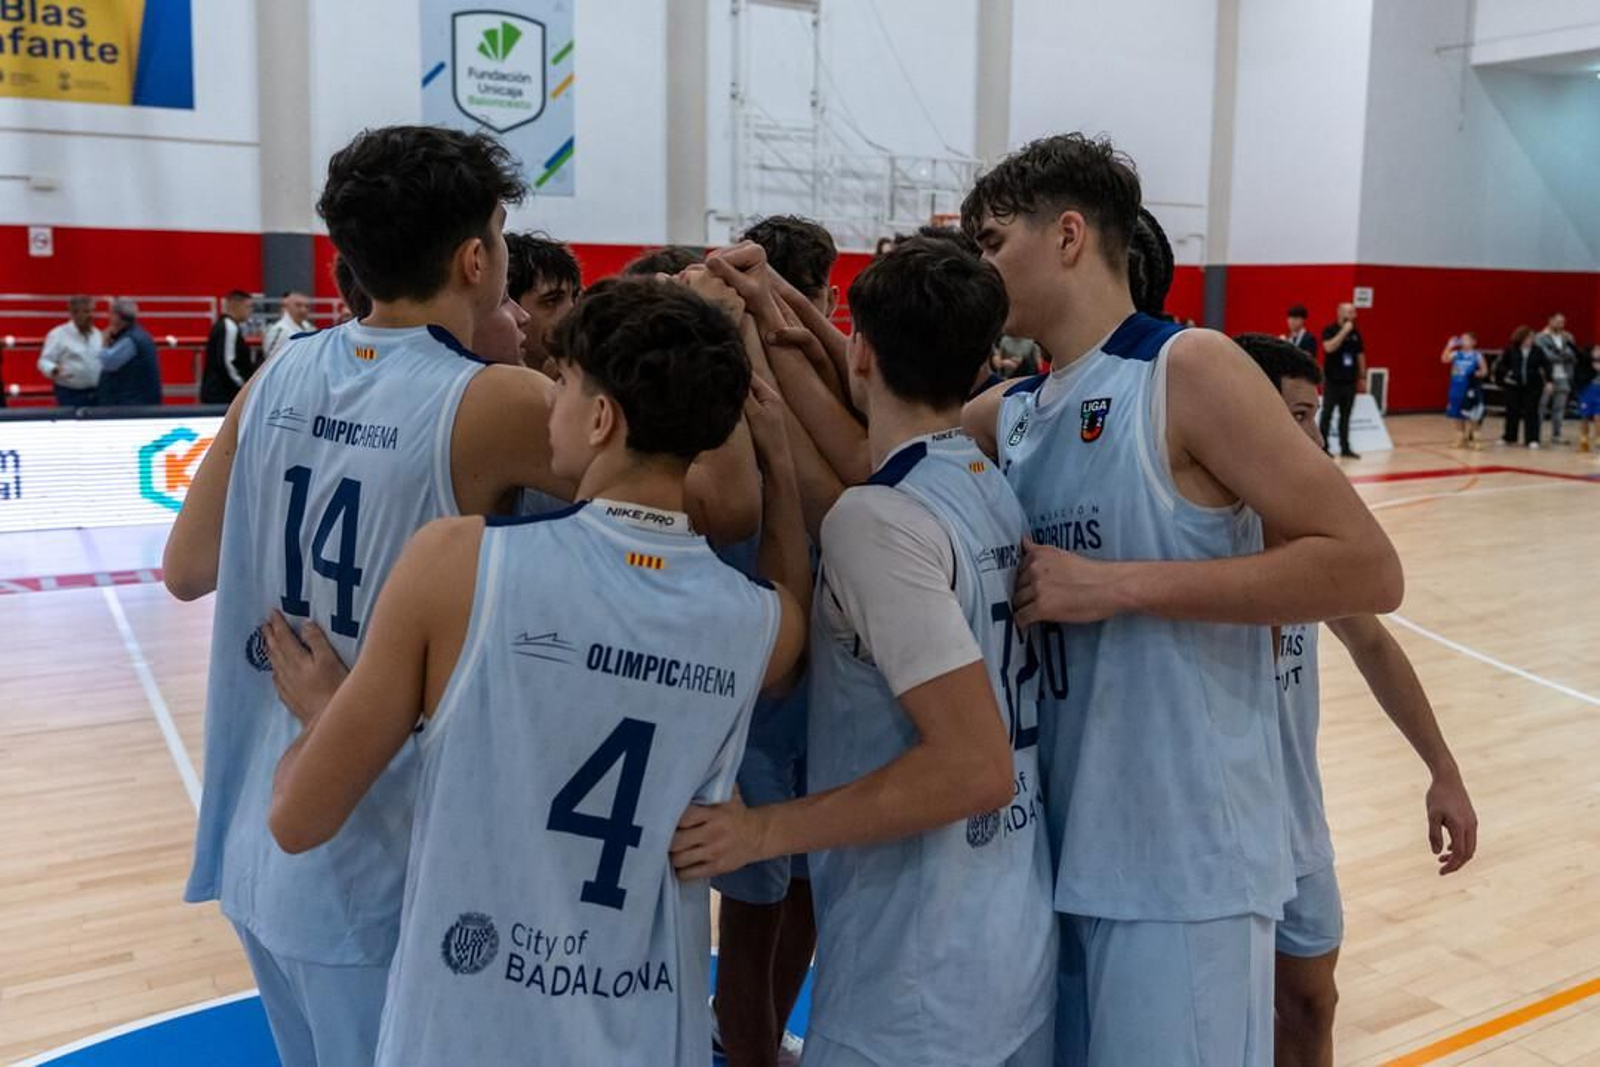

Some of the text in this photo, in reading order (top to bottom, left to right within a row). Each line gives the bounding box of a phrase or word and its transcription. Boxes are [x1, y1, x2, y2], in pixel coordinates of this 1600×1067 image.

[0, 0, 86, 29] Blas
[0, 27, 119, 64] fante
[468, 66, 532, 84] Fundación
[477, 83, 523, 98] Unicaja
[606, 507, 675, 526] NIKE PRO
[280, 465, 363, 639] 14
[586, 643, 736, 698] OLIMPICARENA
[546, 716, 656, 911] 4
[510, 922, 589, 962] City of
[505, 953, 673, 998] BADALONA
